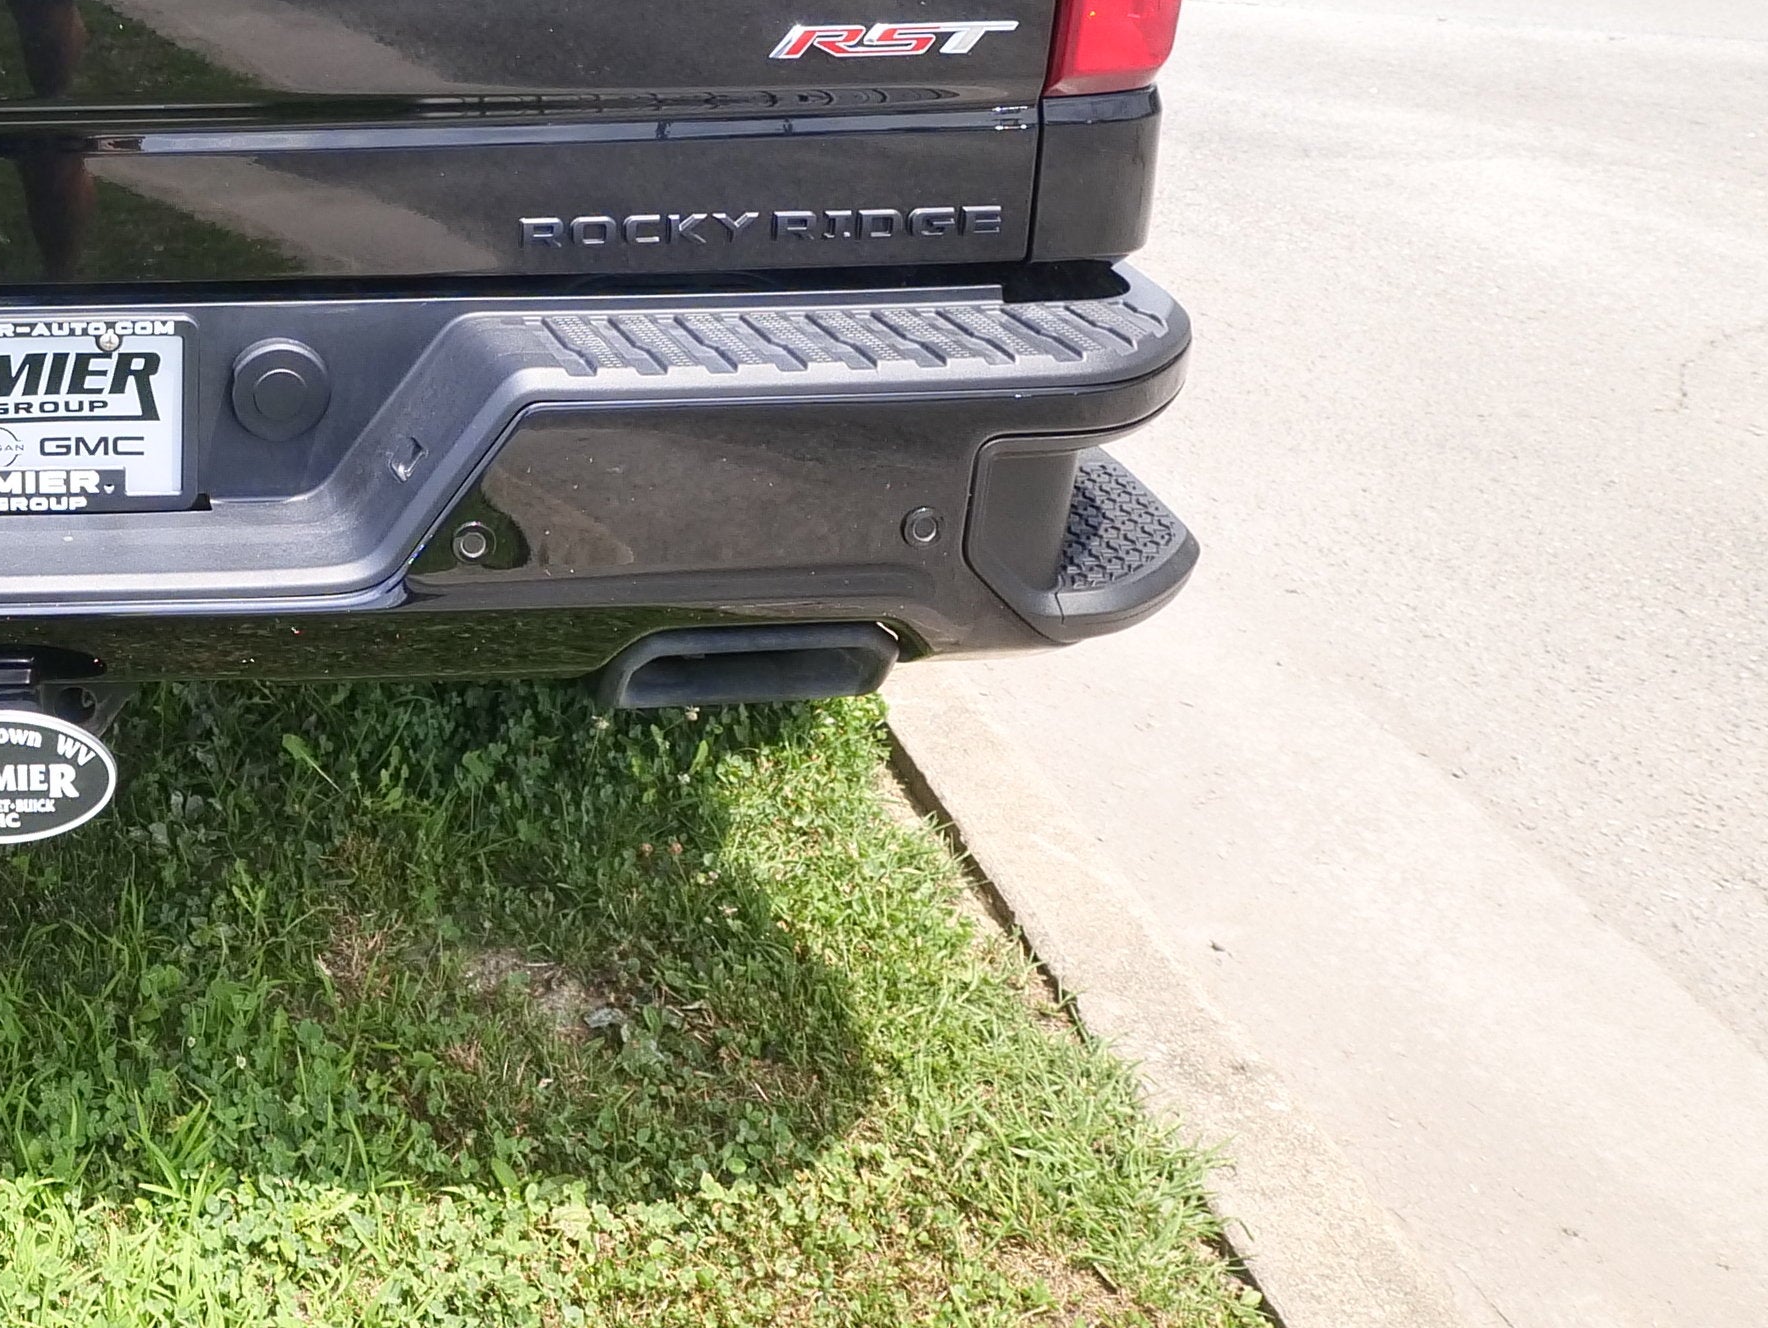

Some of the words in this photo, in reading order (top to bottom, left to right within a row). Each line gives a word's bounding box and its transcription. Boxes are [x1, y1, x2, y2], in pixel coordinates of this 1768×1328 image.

[769, 20, 1020, 59] RST
[519, 211, 760, 248] ROCKY
[770, 205, 1002, 241] RIDGE
[39, 435, 145, 457] GMC
[56, 733, 97, 767] WV
